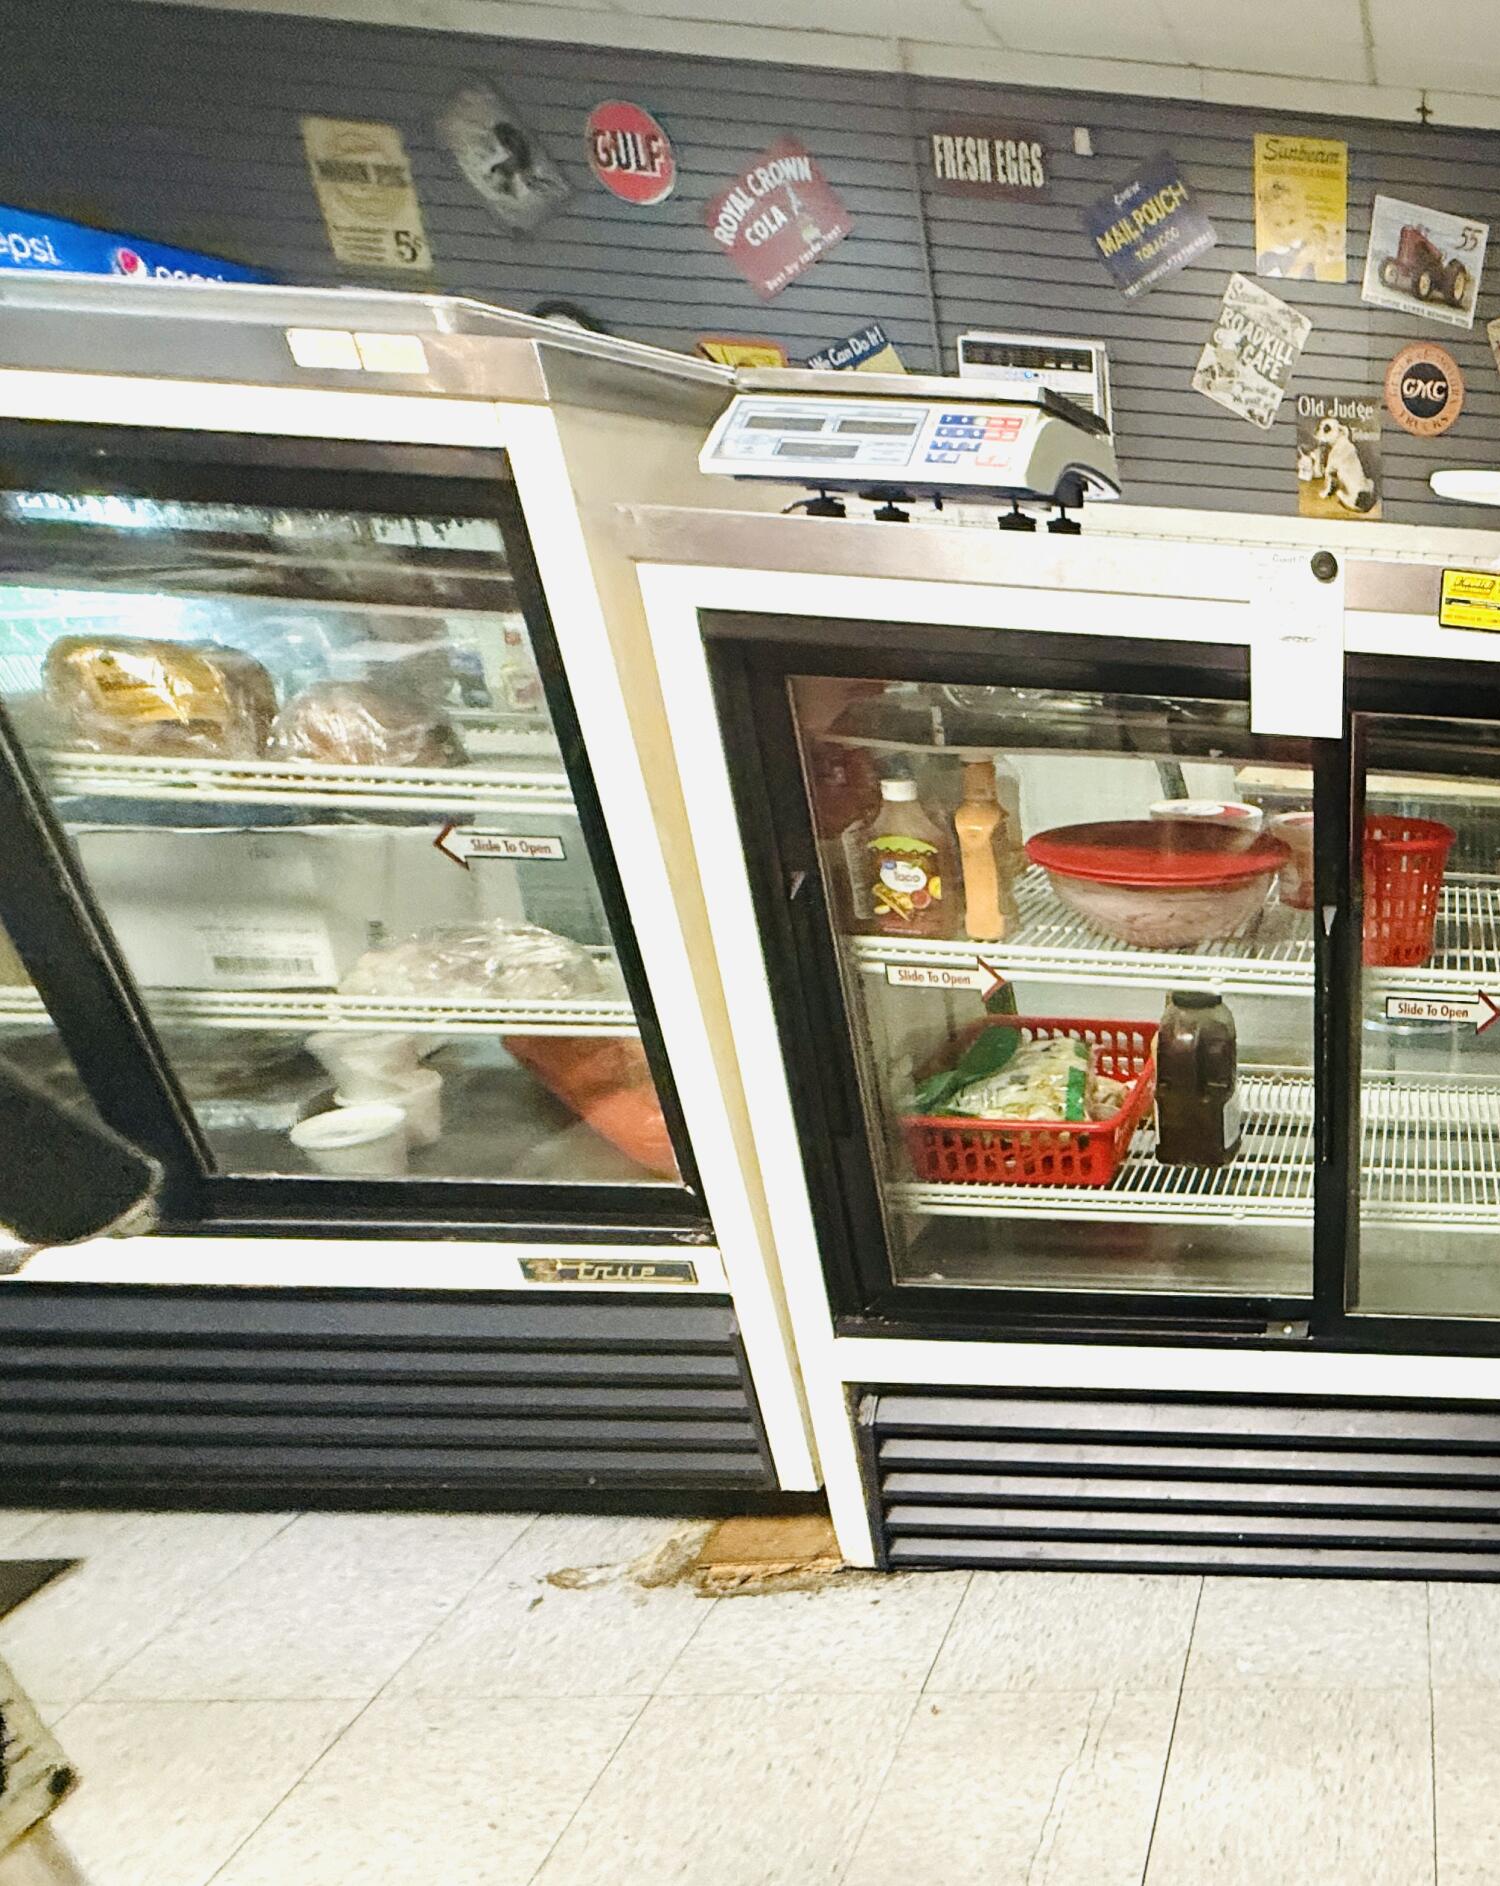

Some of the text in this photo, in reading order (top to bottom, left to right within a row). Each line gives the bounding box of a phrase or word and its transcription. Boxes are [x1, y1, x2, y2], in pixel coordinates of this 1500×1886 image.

[592, 129, 664, 177] GULF
[933, 134, 1045, 188] FRESH EGGS
[714, 156, 812, 247] ROYAL CROWN
[1096, 180, 1189, 258] MAIL POUCH
[744, 205, 788, 247] COLA
[828, 346, 851, 367] Can
[850, 337, 870, 357] Do
[1219, 306, 1294, 367] ROADKILL
[1241, 344, 1283, 381] CAFE
[1402, 377, 1447, 402] GMC
[1297, 395, 1375, 422] Old Judge
[502, 840, 518, 853] To
[519, 841, 553, 857] Open
[898, 968, 971, 986] Slide To Open
[1397, 1003, 1469, 1019] Slide To Open
